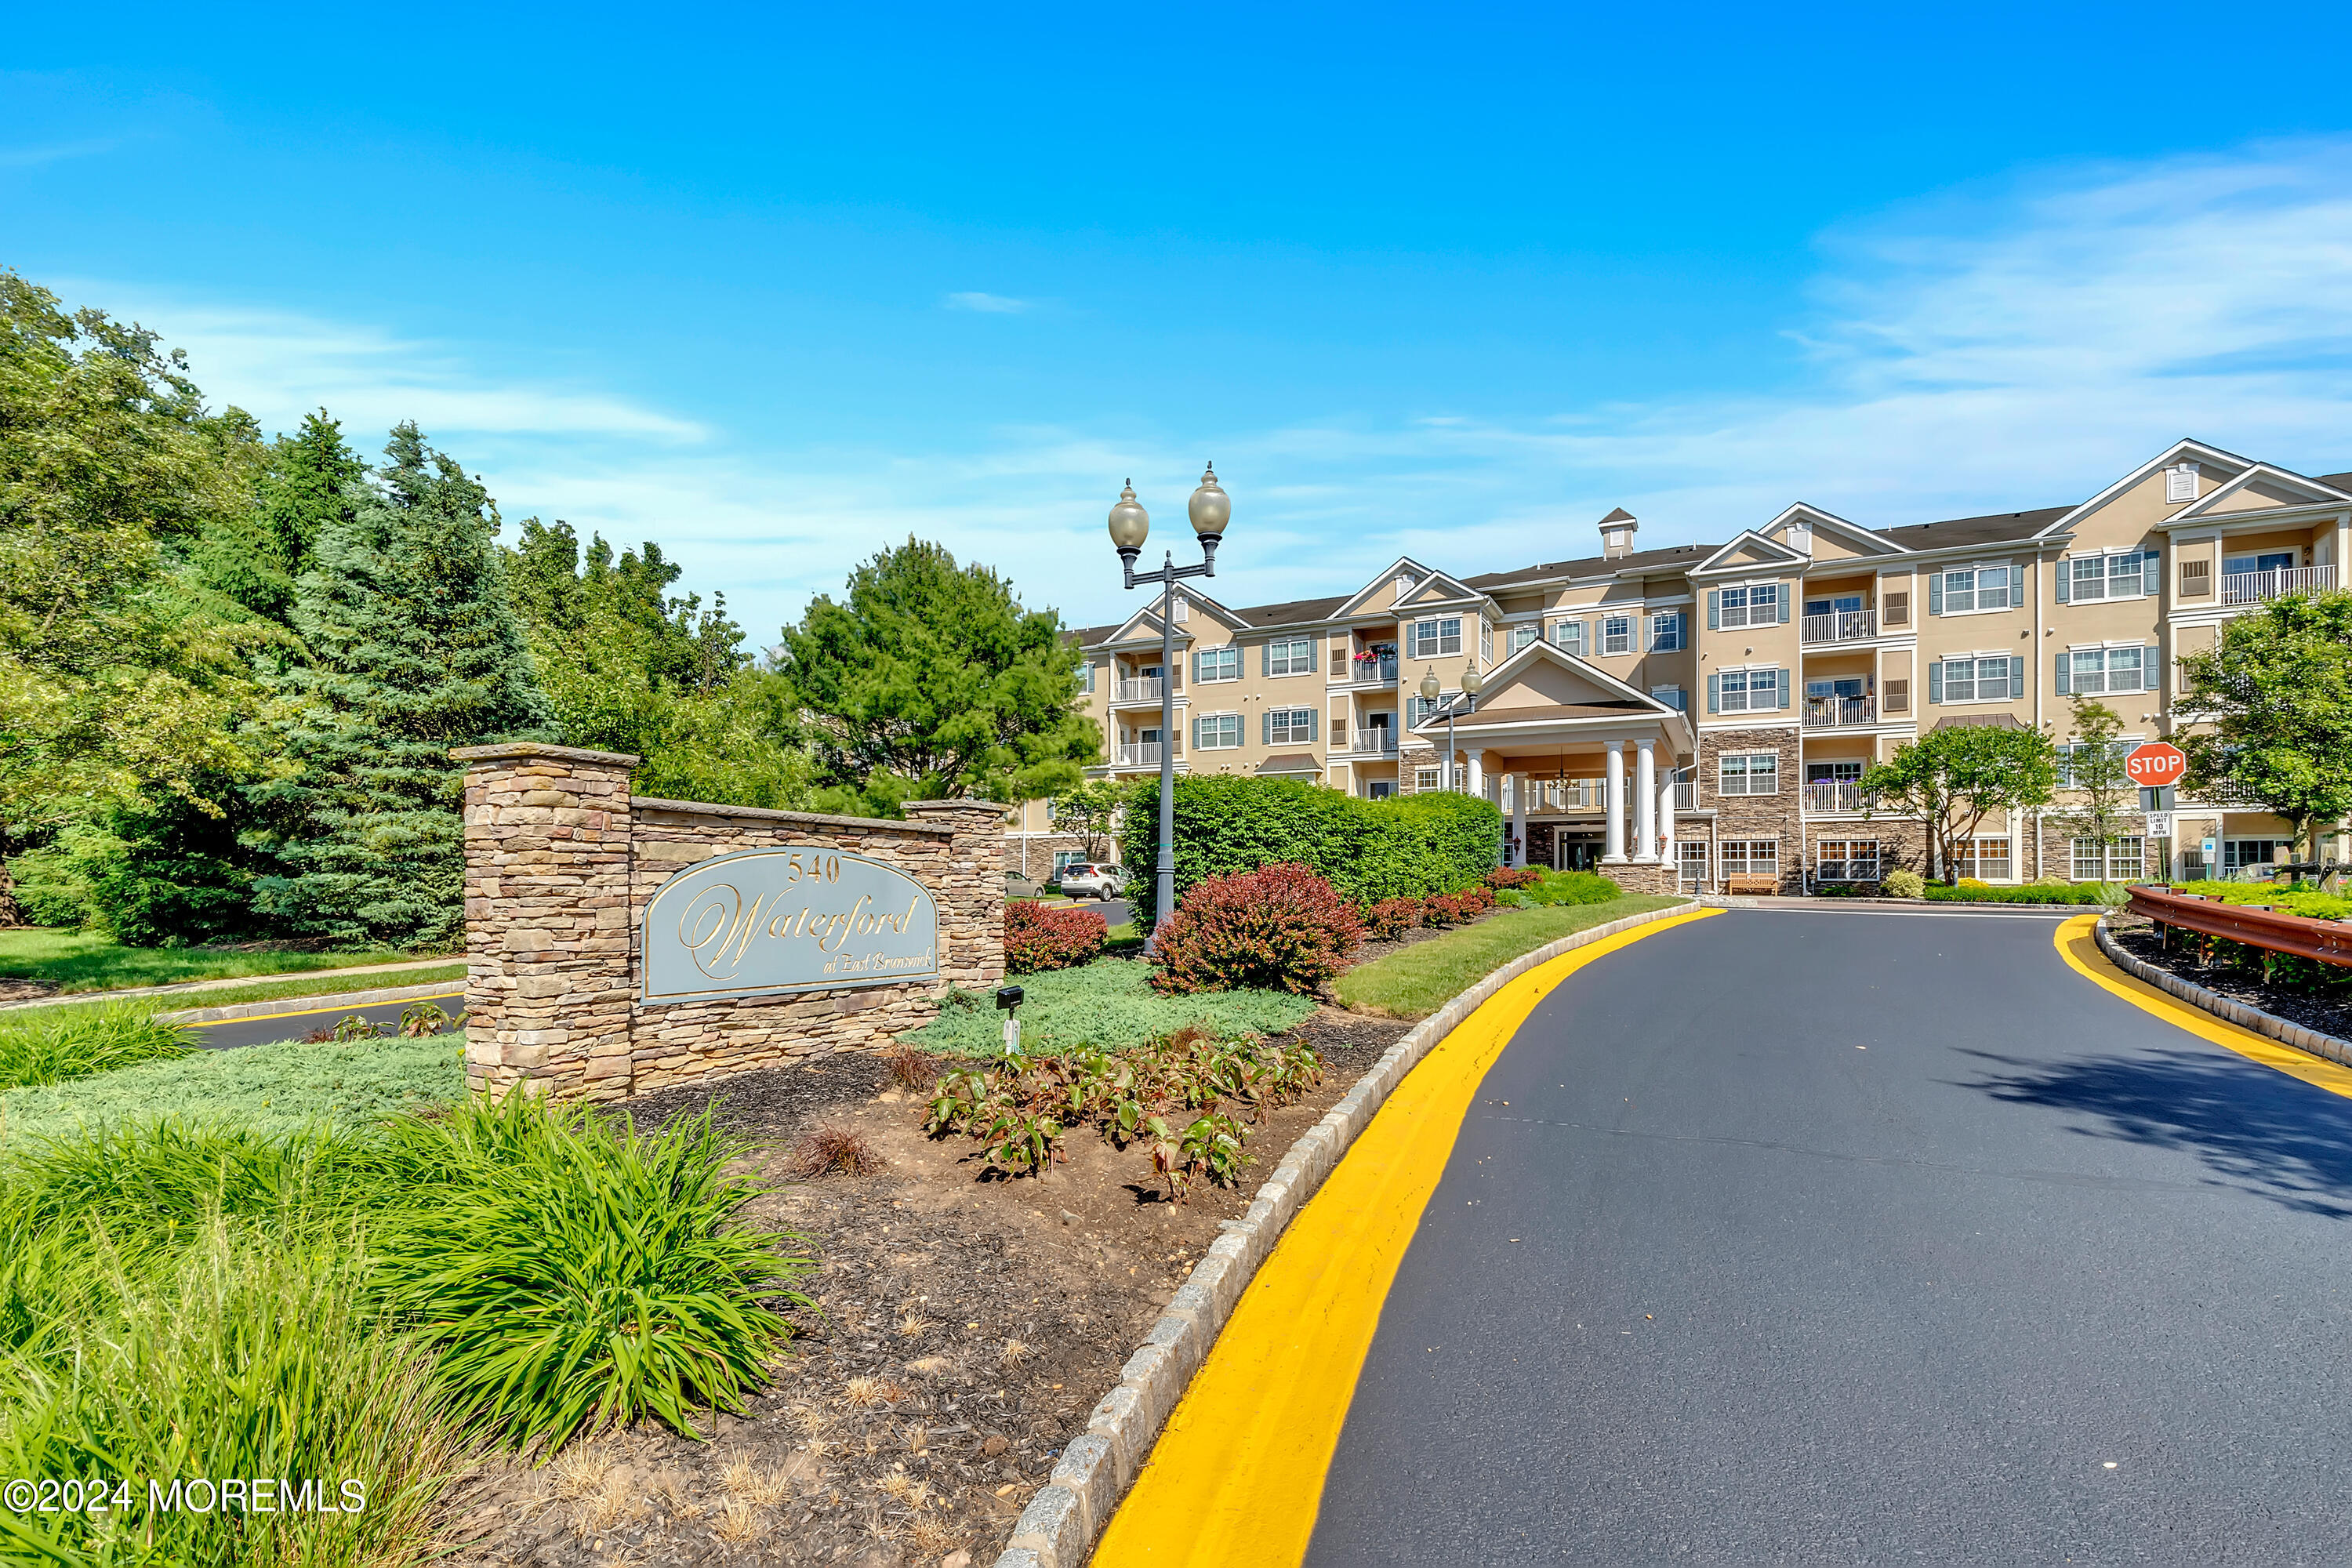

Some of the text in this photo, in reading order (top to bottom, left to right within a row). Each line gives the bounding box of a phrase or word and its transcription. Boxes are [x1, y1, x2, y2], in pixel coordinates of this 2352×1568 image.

[2130, 755, 2180, 774] STOP
[787, 854, 840, 884] 540
[678, 884, 919, 980] Waterford
[822, 946, 933, 973] at East Brunswick
